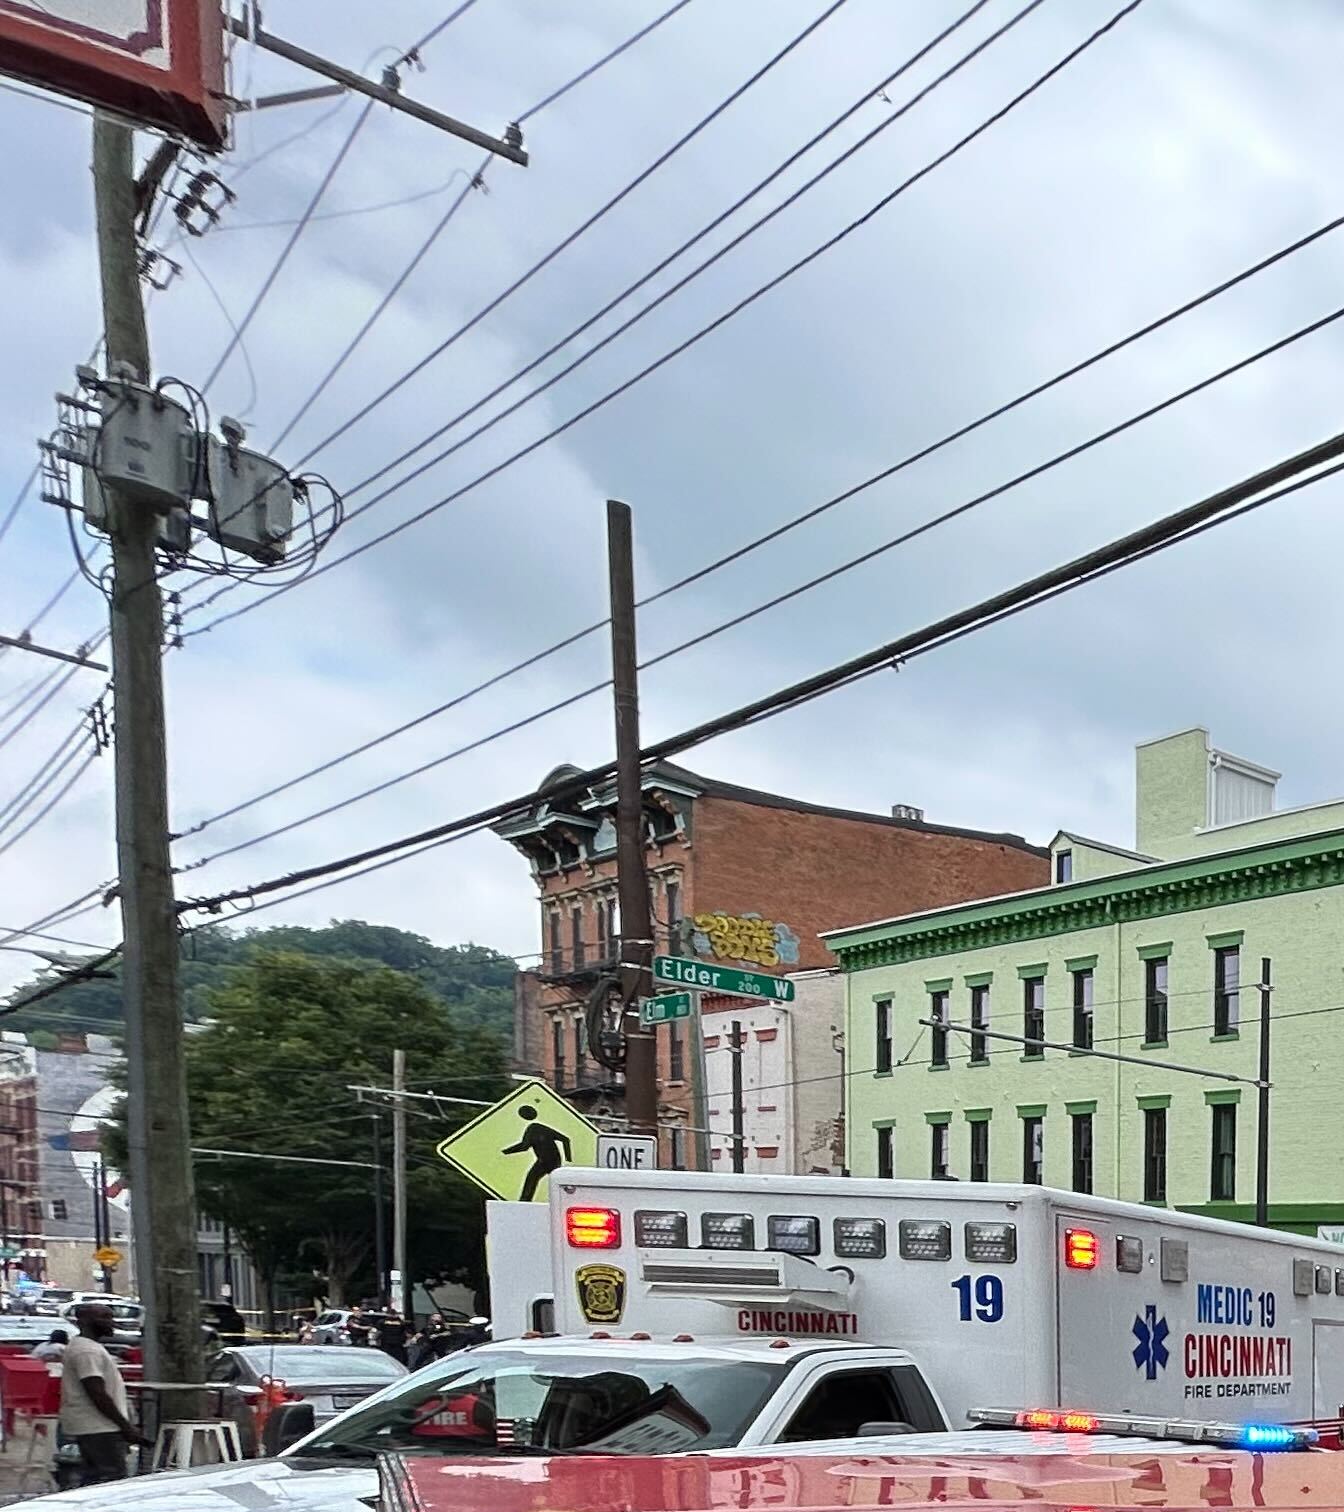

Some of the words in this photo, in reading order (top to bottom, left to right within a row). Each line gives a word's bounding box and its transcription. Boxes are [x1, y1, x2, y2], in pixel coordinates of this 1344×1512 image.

[661, 958, 721, 986] Elder
[774, 980, 789, 998] W
[738, 981, 761, 994] 200
[606, 1146, 645, 1169] ONE
[951, 1274, 1004, 1323] 19
[1197, 1283, 1253, 1326] MEDIC
[1258, 1291, 1275, 1328] 19
[737, 1309, 858, 1335] CINCINNATI
[1184, 1333, 1292, 1378] CINCINNATI
[1184, 1385, 1212, 1398] FIRE
[1217, 1382, 1292, 1397] DEPARTMENT
